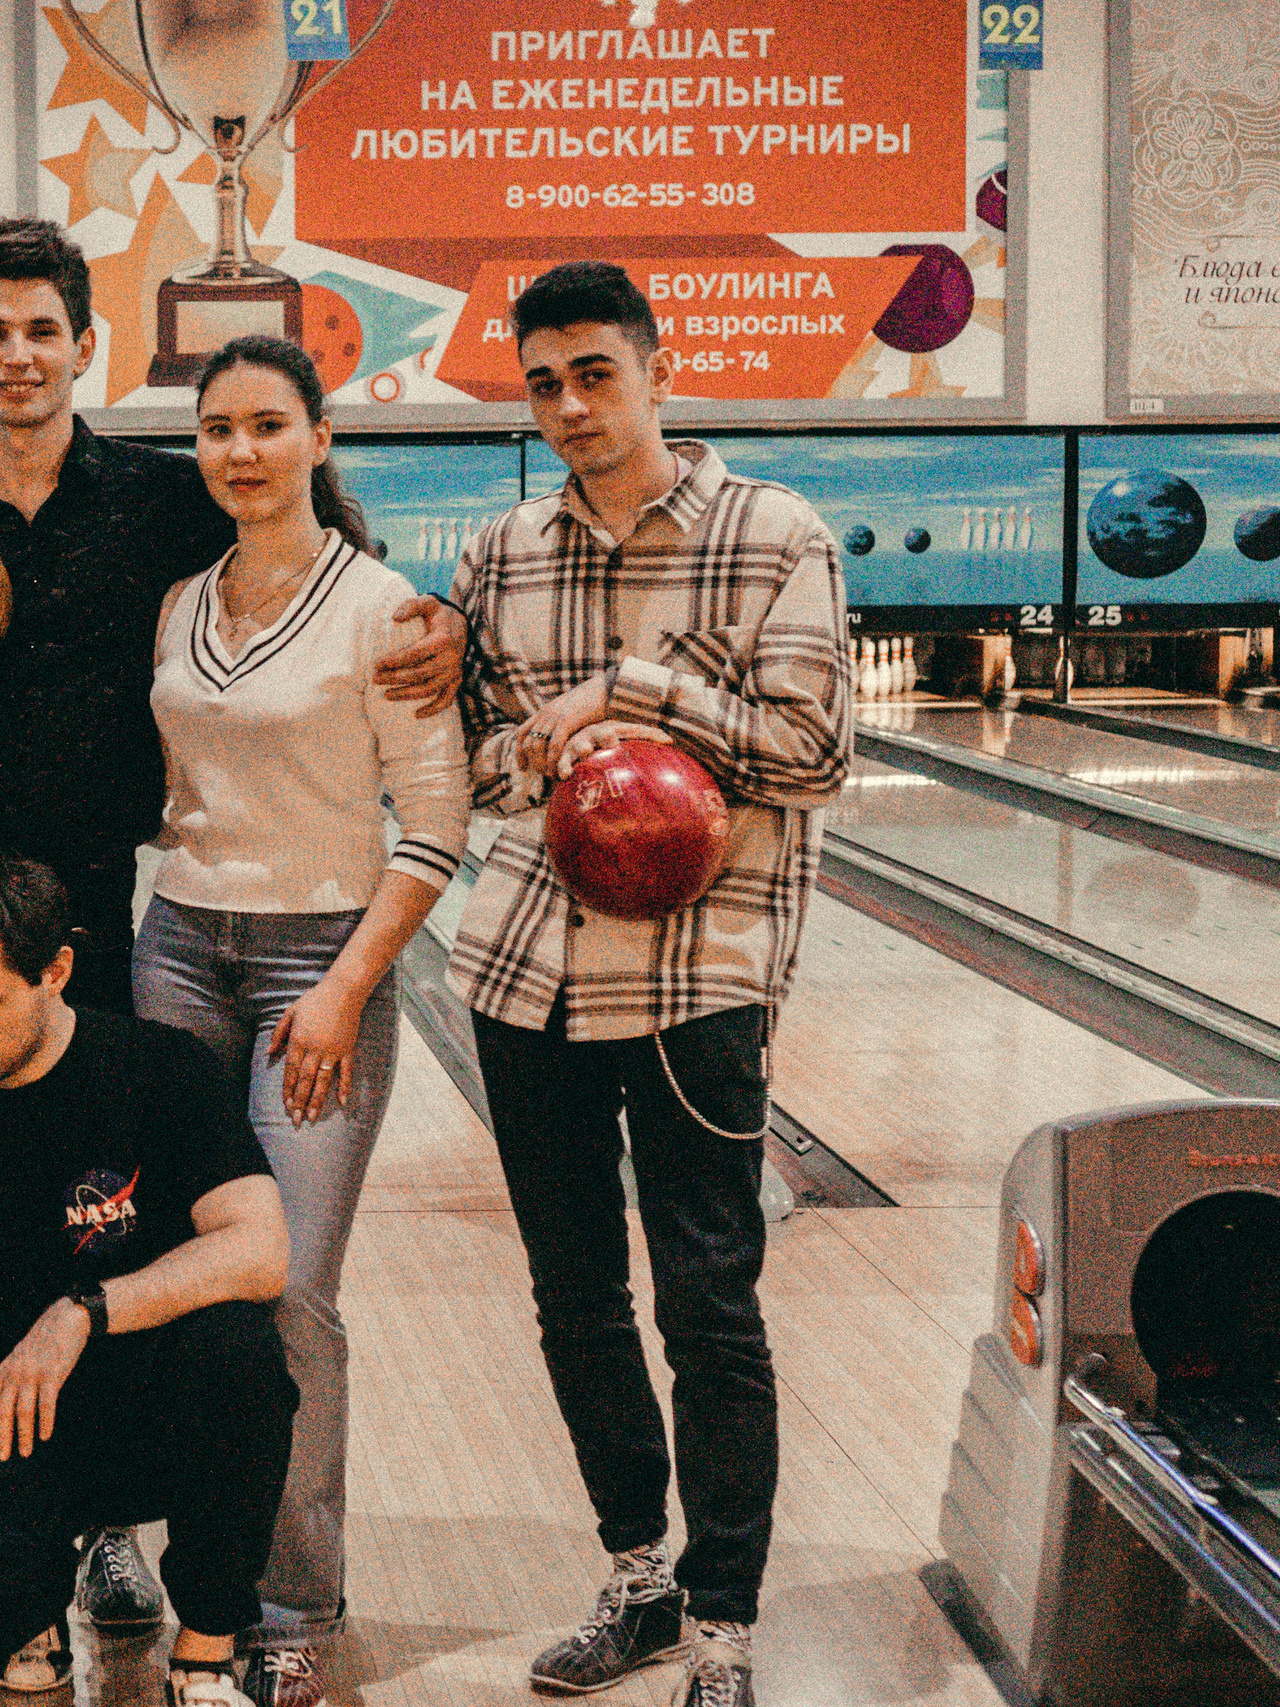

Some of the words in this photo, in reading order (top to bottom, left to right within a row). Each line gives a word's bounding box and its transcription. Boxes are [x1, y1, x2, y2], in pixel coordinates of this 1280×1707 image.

[291, 0, 342, 36] 21
[983, 4, 1040, 43] 22
[491, 27, 775, 61] ПРИГЛАШАЕТ
[421, 79, 477, 111] НА
[492, 75, 844, 115] ЕЖЕНЕДЕЛЬНЫЕ
[351, 125, 694, 160] ЛЮБИТЕЛЬСКИЕ
[708, 122, 911, 155] ТУРНИРЫ
[1175, 254, 1263, 286] Блюда
[649, 272, 836, 300] БОУЛИНГА
[1184, 287, 1201, 304] и
[1210, 286, 1280, 304] японс
[656, 316, 674, 336] и
[685, 313, 846, 342] взрослых
[1020, 605, 1053, 625] 24
[1088, 606, 1122, 626] 25
[65, 1199, 137, 1226] NASA
